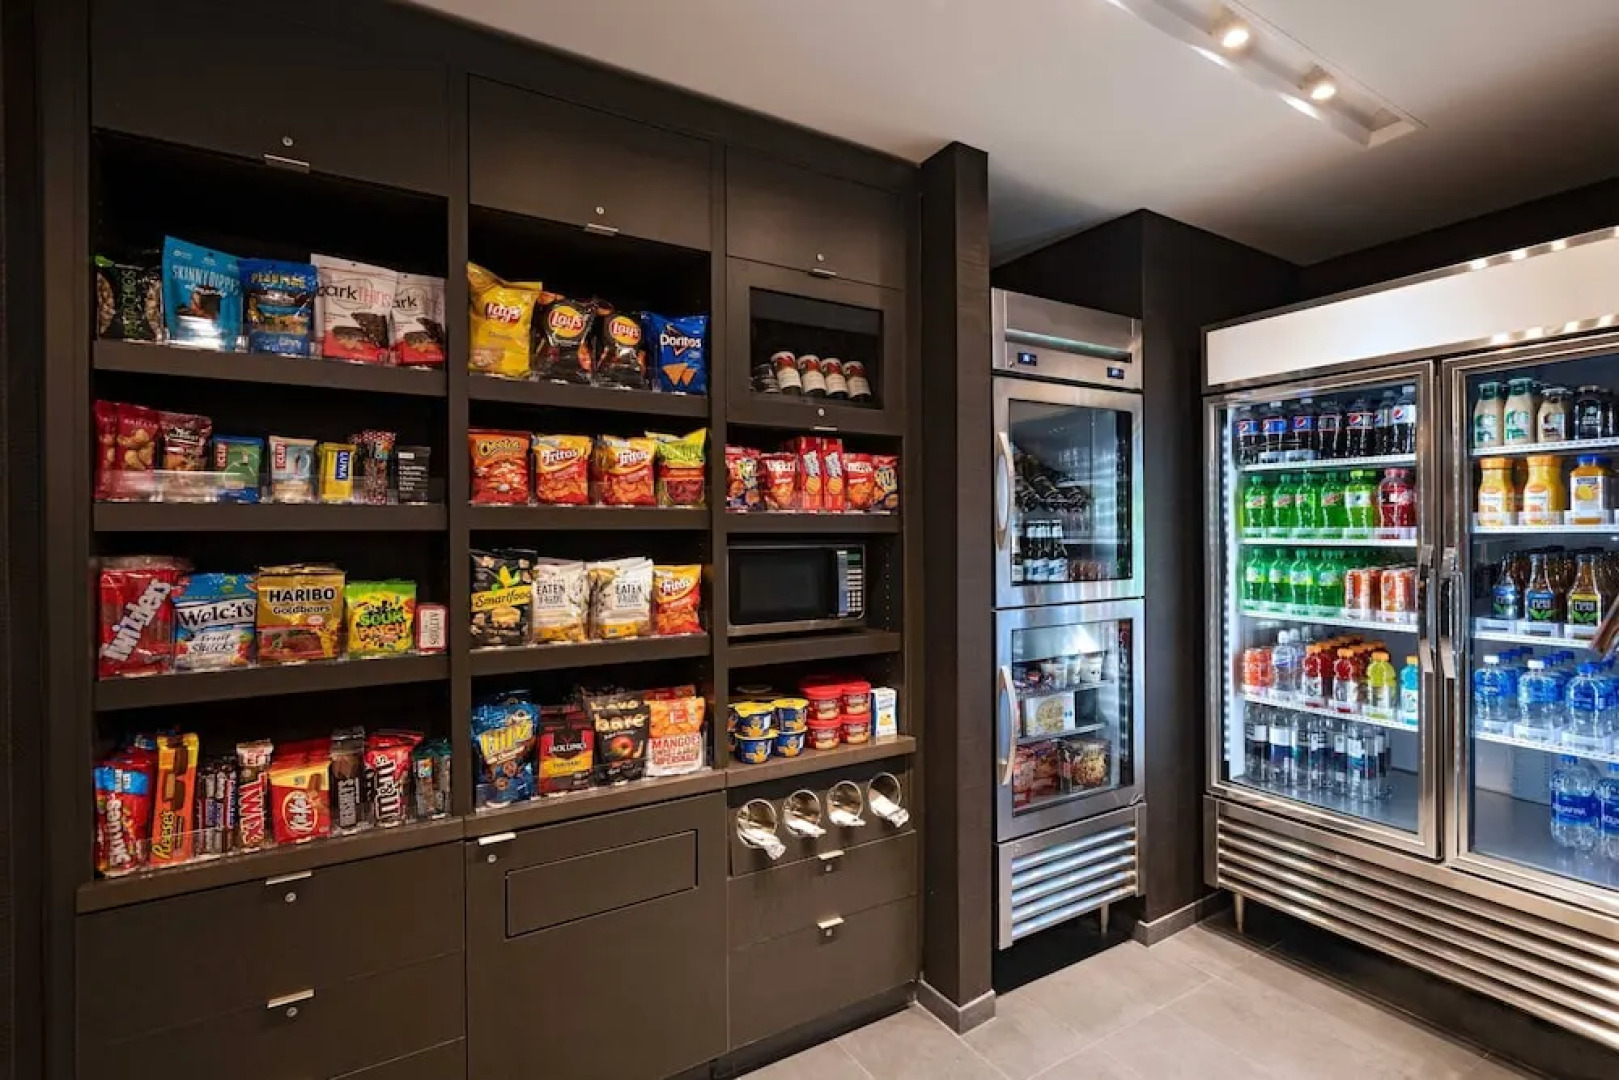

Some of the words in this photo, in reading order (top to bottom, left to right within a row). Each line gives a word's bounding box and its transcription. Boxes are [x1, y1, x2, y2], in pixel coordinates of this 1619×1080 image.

[660, 334, 702, 348] Doritos
[338, 451, 350, 480] LUNA
[542, 449, 578, 467] Fritos
[269, 588, 336, 603] HARIBO
[537, 584, 565, 595] EATEN
[272, 604, 332, 616] Goldbears
[594, 713, 649, 732] bare
